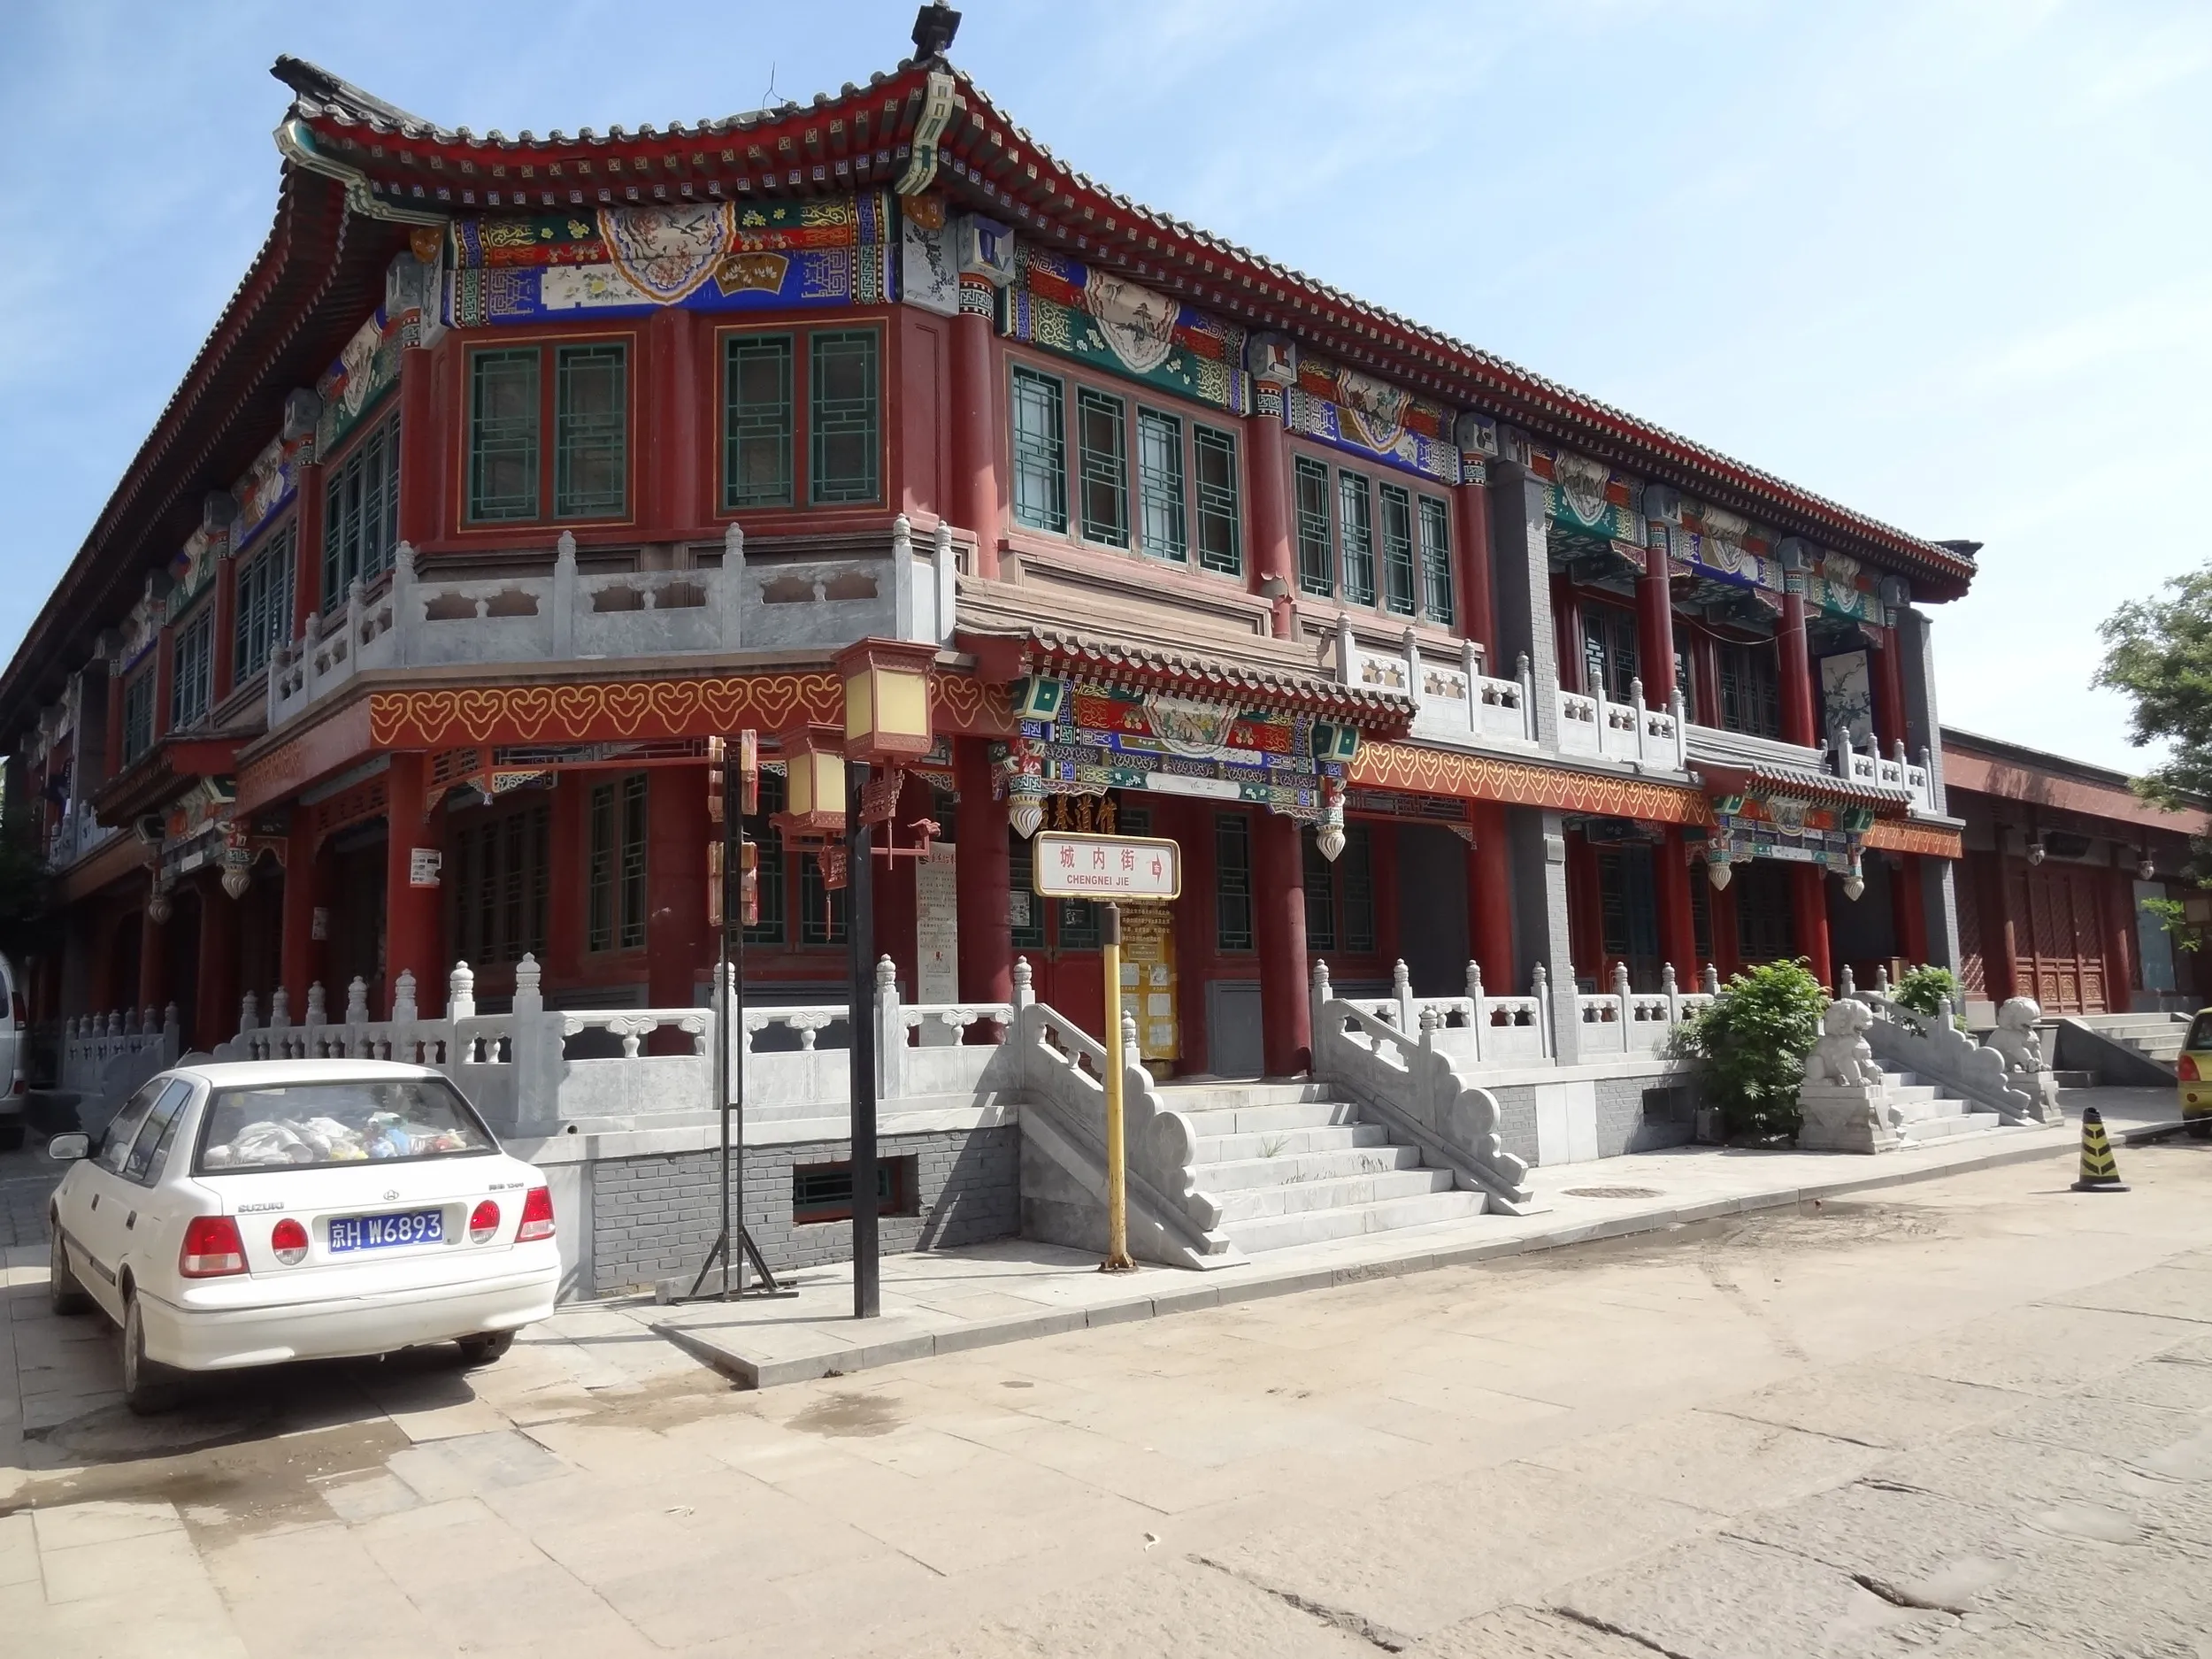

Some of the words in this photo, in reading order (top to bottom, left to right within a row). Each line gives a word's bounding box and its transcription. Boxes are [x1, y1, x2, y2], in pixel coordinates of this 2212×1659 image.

[1060, 845, 1134, 872] 城内街
[1066, 874, 1112, 886] CHENGNEI
[1116, 876, 1129, 887] JIE
[238, 1202, 285, 1213] SUZUKI
